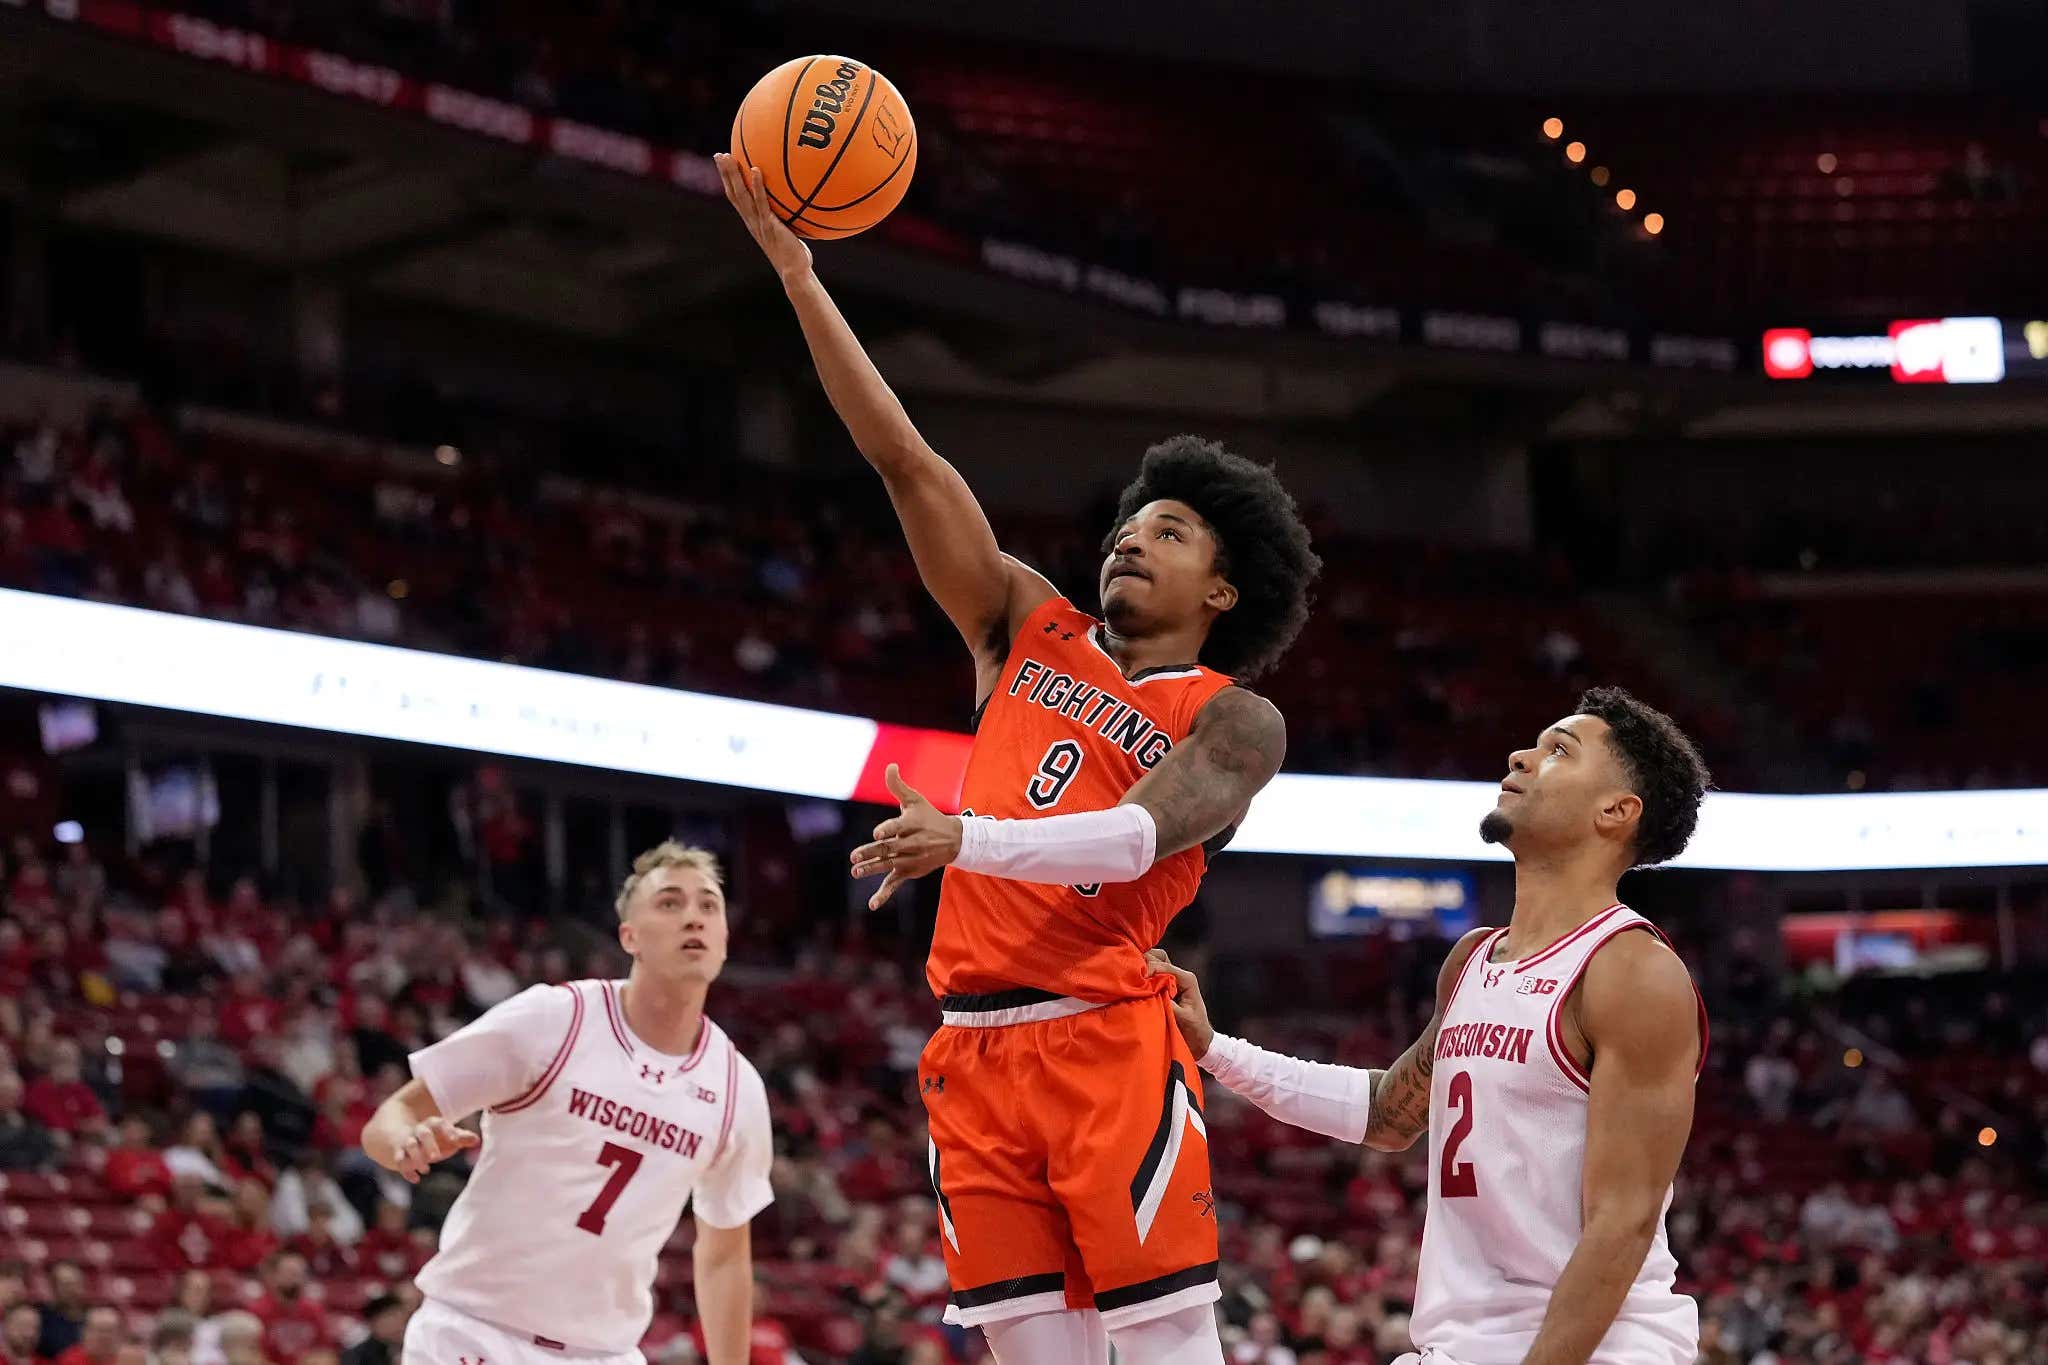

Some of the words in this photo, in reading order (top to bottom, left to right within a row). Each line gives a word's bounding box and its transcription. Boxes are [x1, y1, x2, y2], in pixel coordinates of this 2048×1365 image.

[797, 61, 863, 150] Wilson
[1008, 658, 1174, 769] FIGHTING
[1025, 739, 1084, 810] 9
[1434, 1022, 1534, 1064] WISCONSIN
[567, 1087, 704, 1160] WISCONSIN
[1440, 1070, 1478, 1198] 2
[576, 1141, 644, 1236] 7
